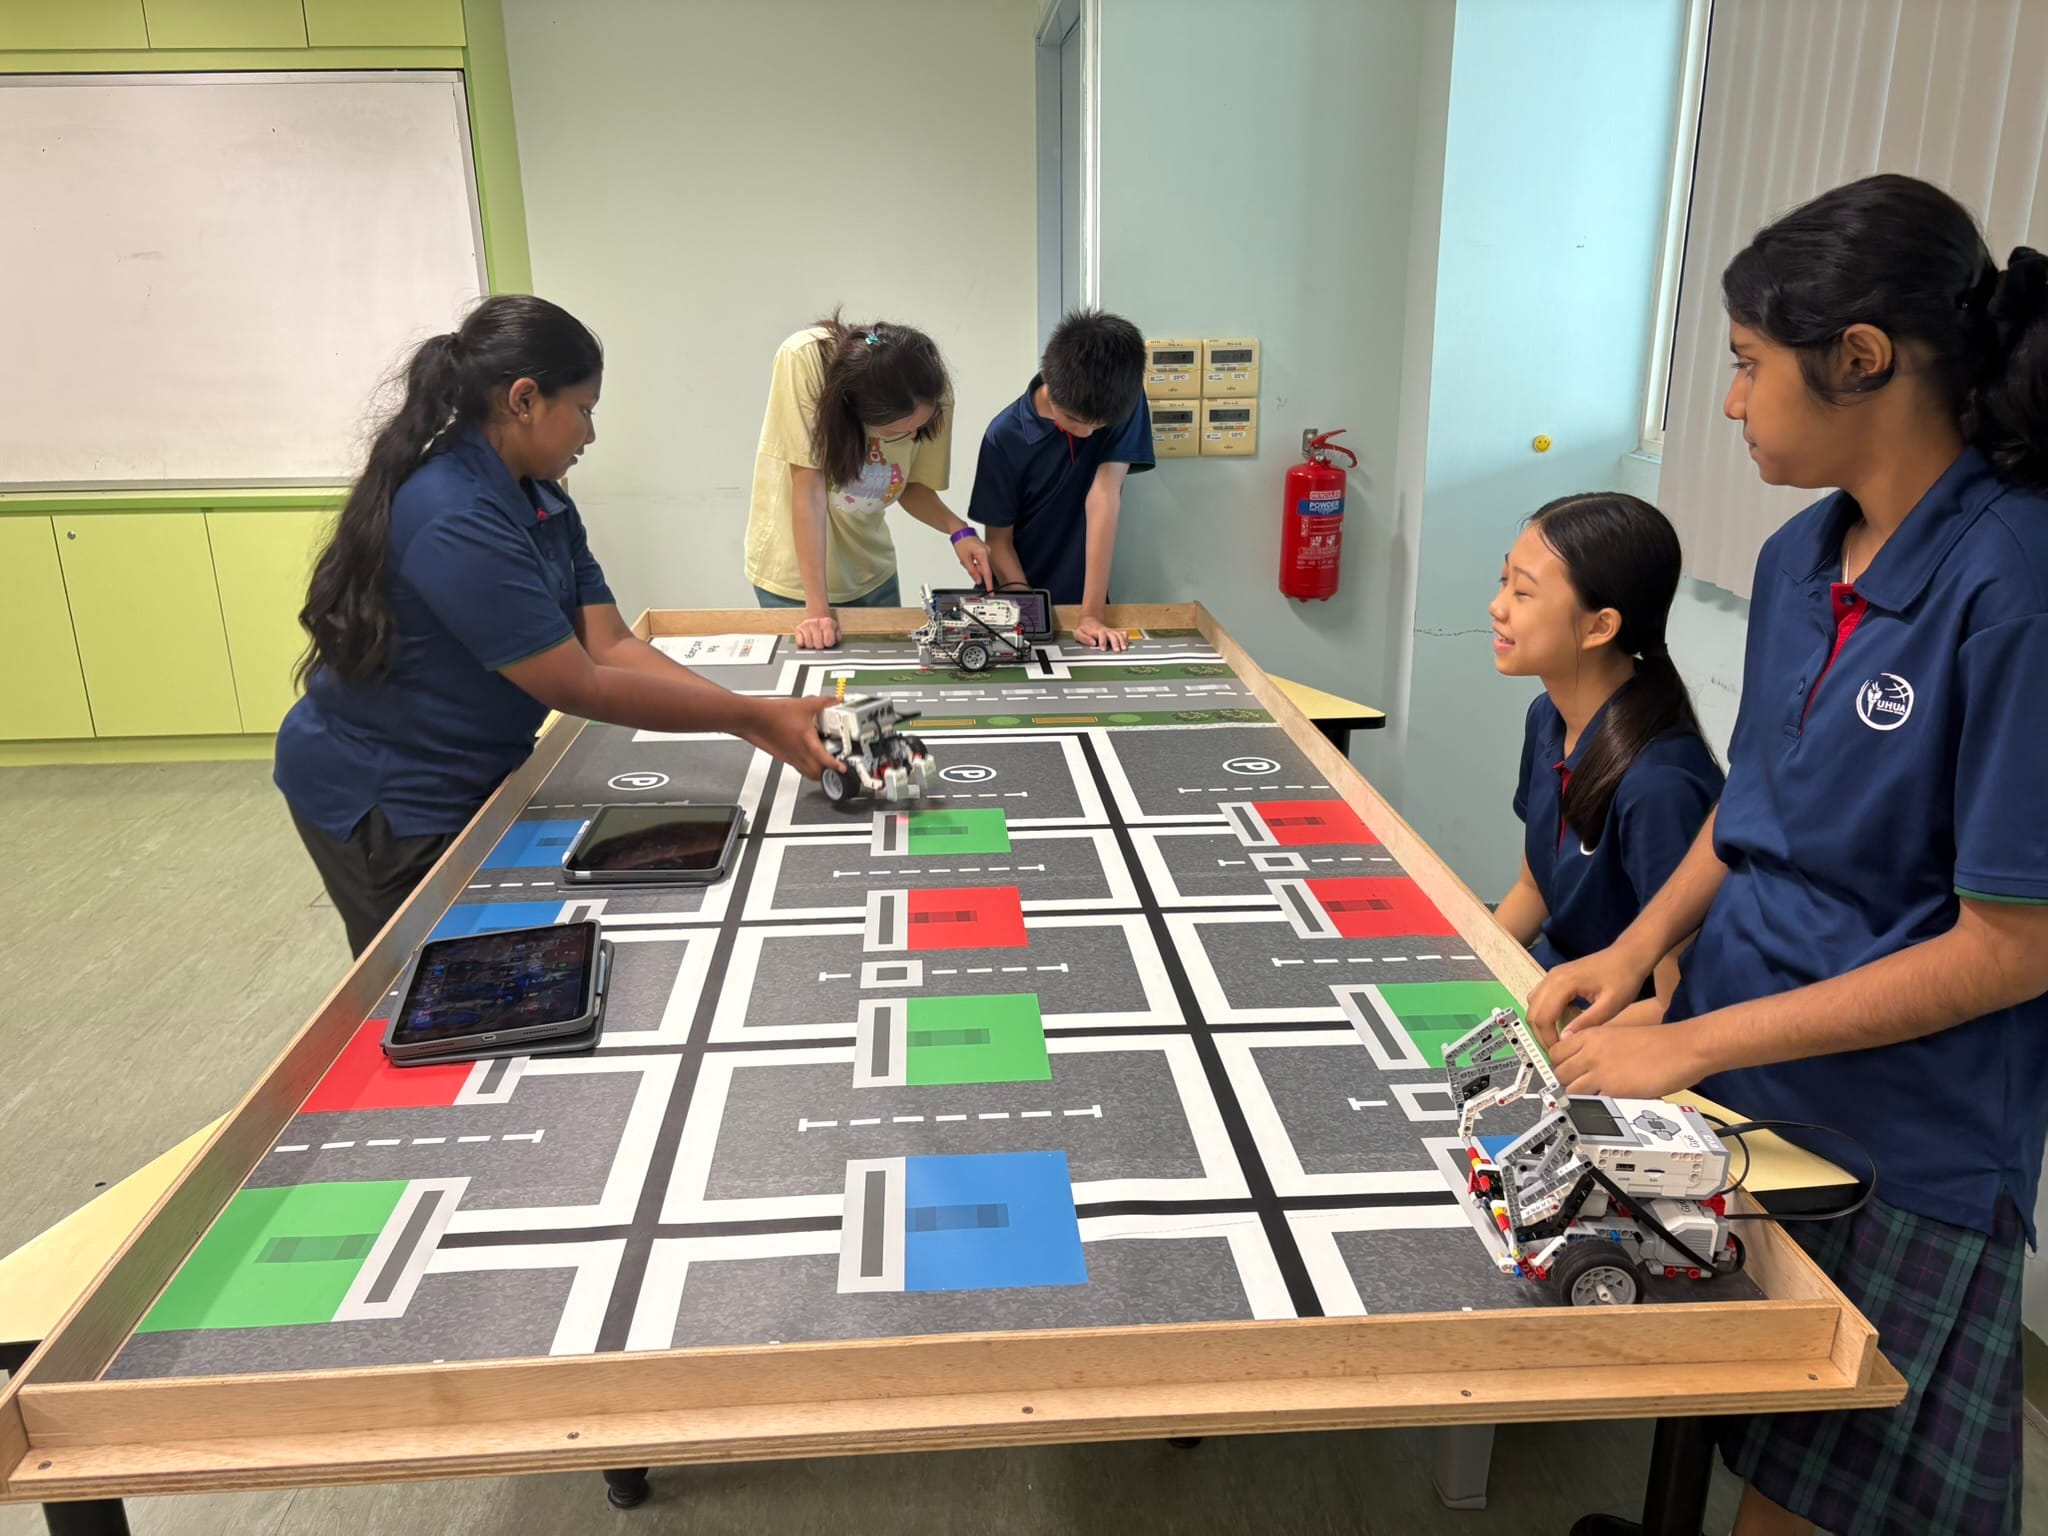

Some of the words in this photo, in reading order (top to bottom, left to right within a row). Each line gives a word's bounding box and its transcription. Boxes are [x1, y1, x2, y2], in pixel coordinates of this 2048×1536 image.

[1309, 501, 1340, 510] POWDER
[1232, 762, 1270, 770] P
[950, 770, 986, 779] P
[621, 776, 658, 786] P
